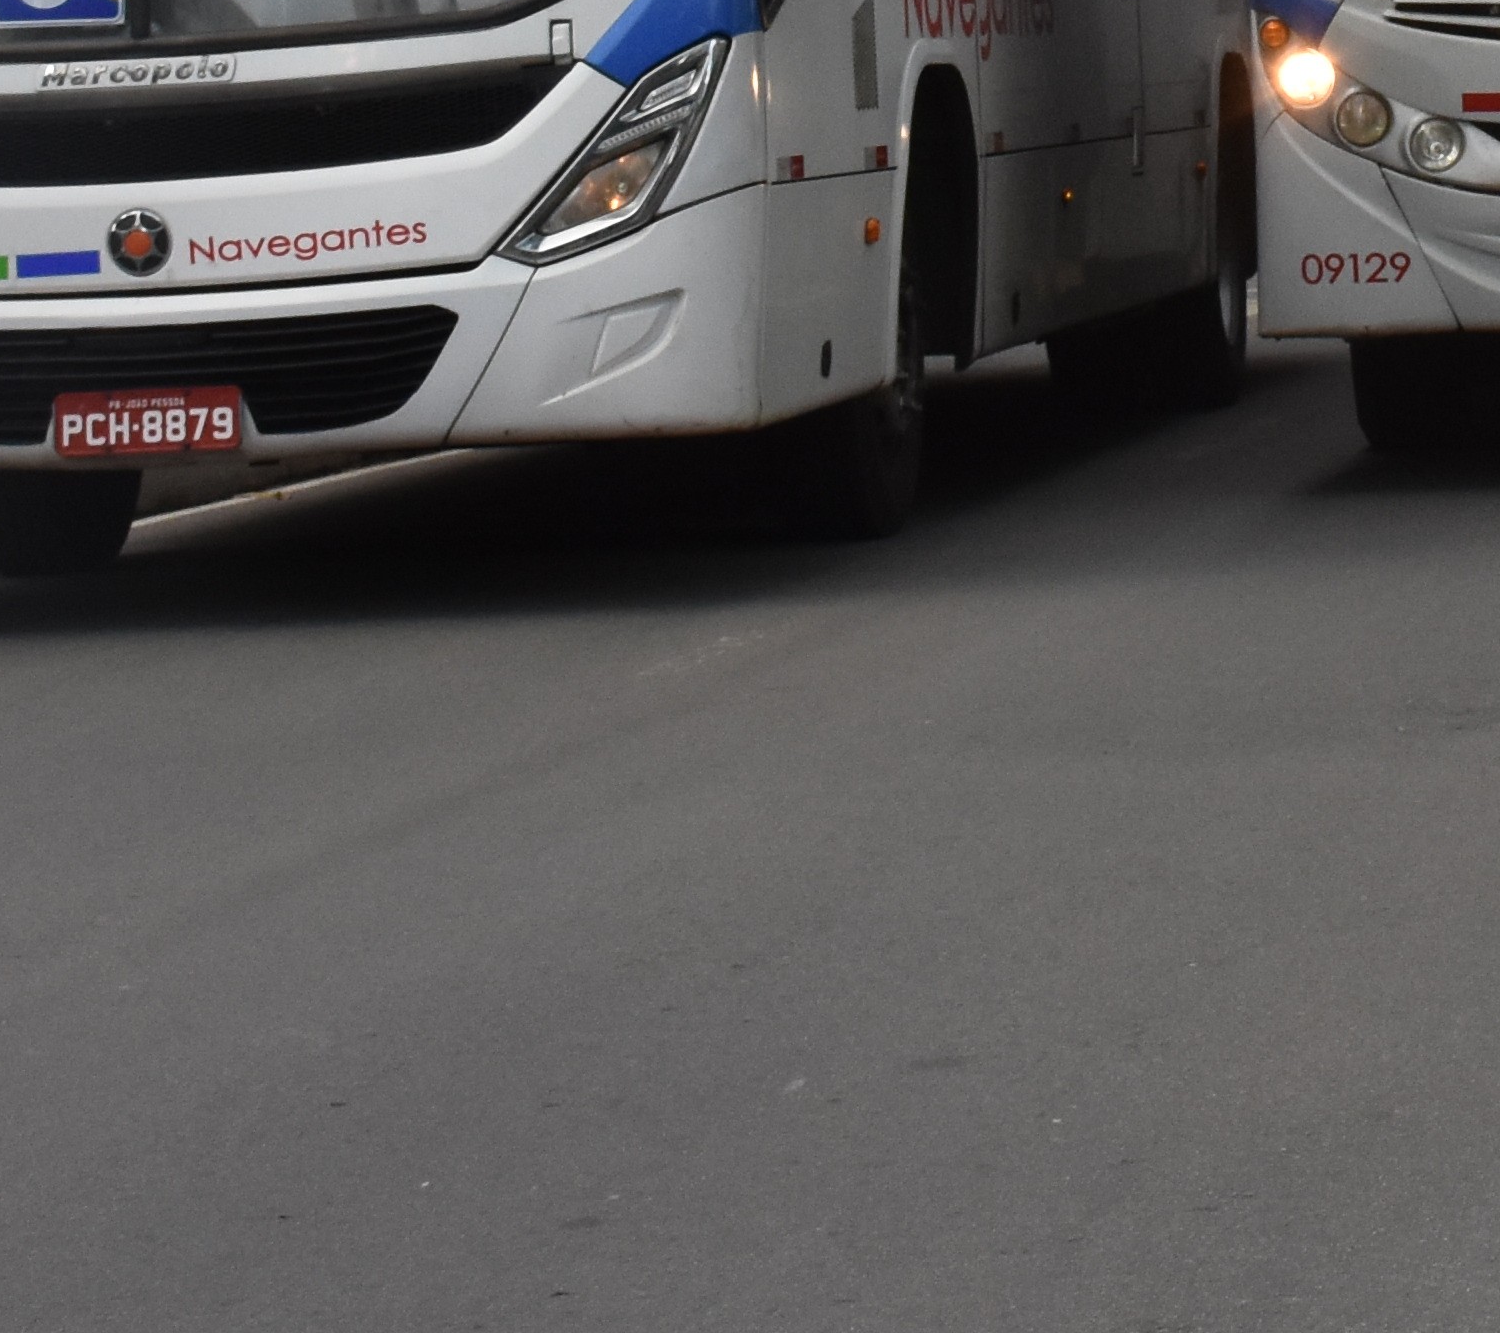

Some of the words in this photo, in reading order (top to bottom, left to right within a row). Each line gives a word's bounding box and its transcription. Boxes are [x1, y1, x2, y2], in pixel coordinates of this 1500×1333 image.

[40, 55, 230, 89] Marcopolo
[188, 219, 428, 265] Navegantes
[1300, 252, 1412, 285] 09129
